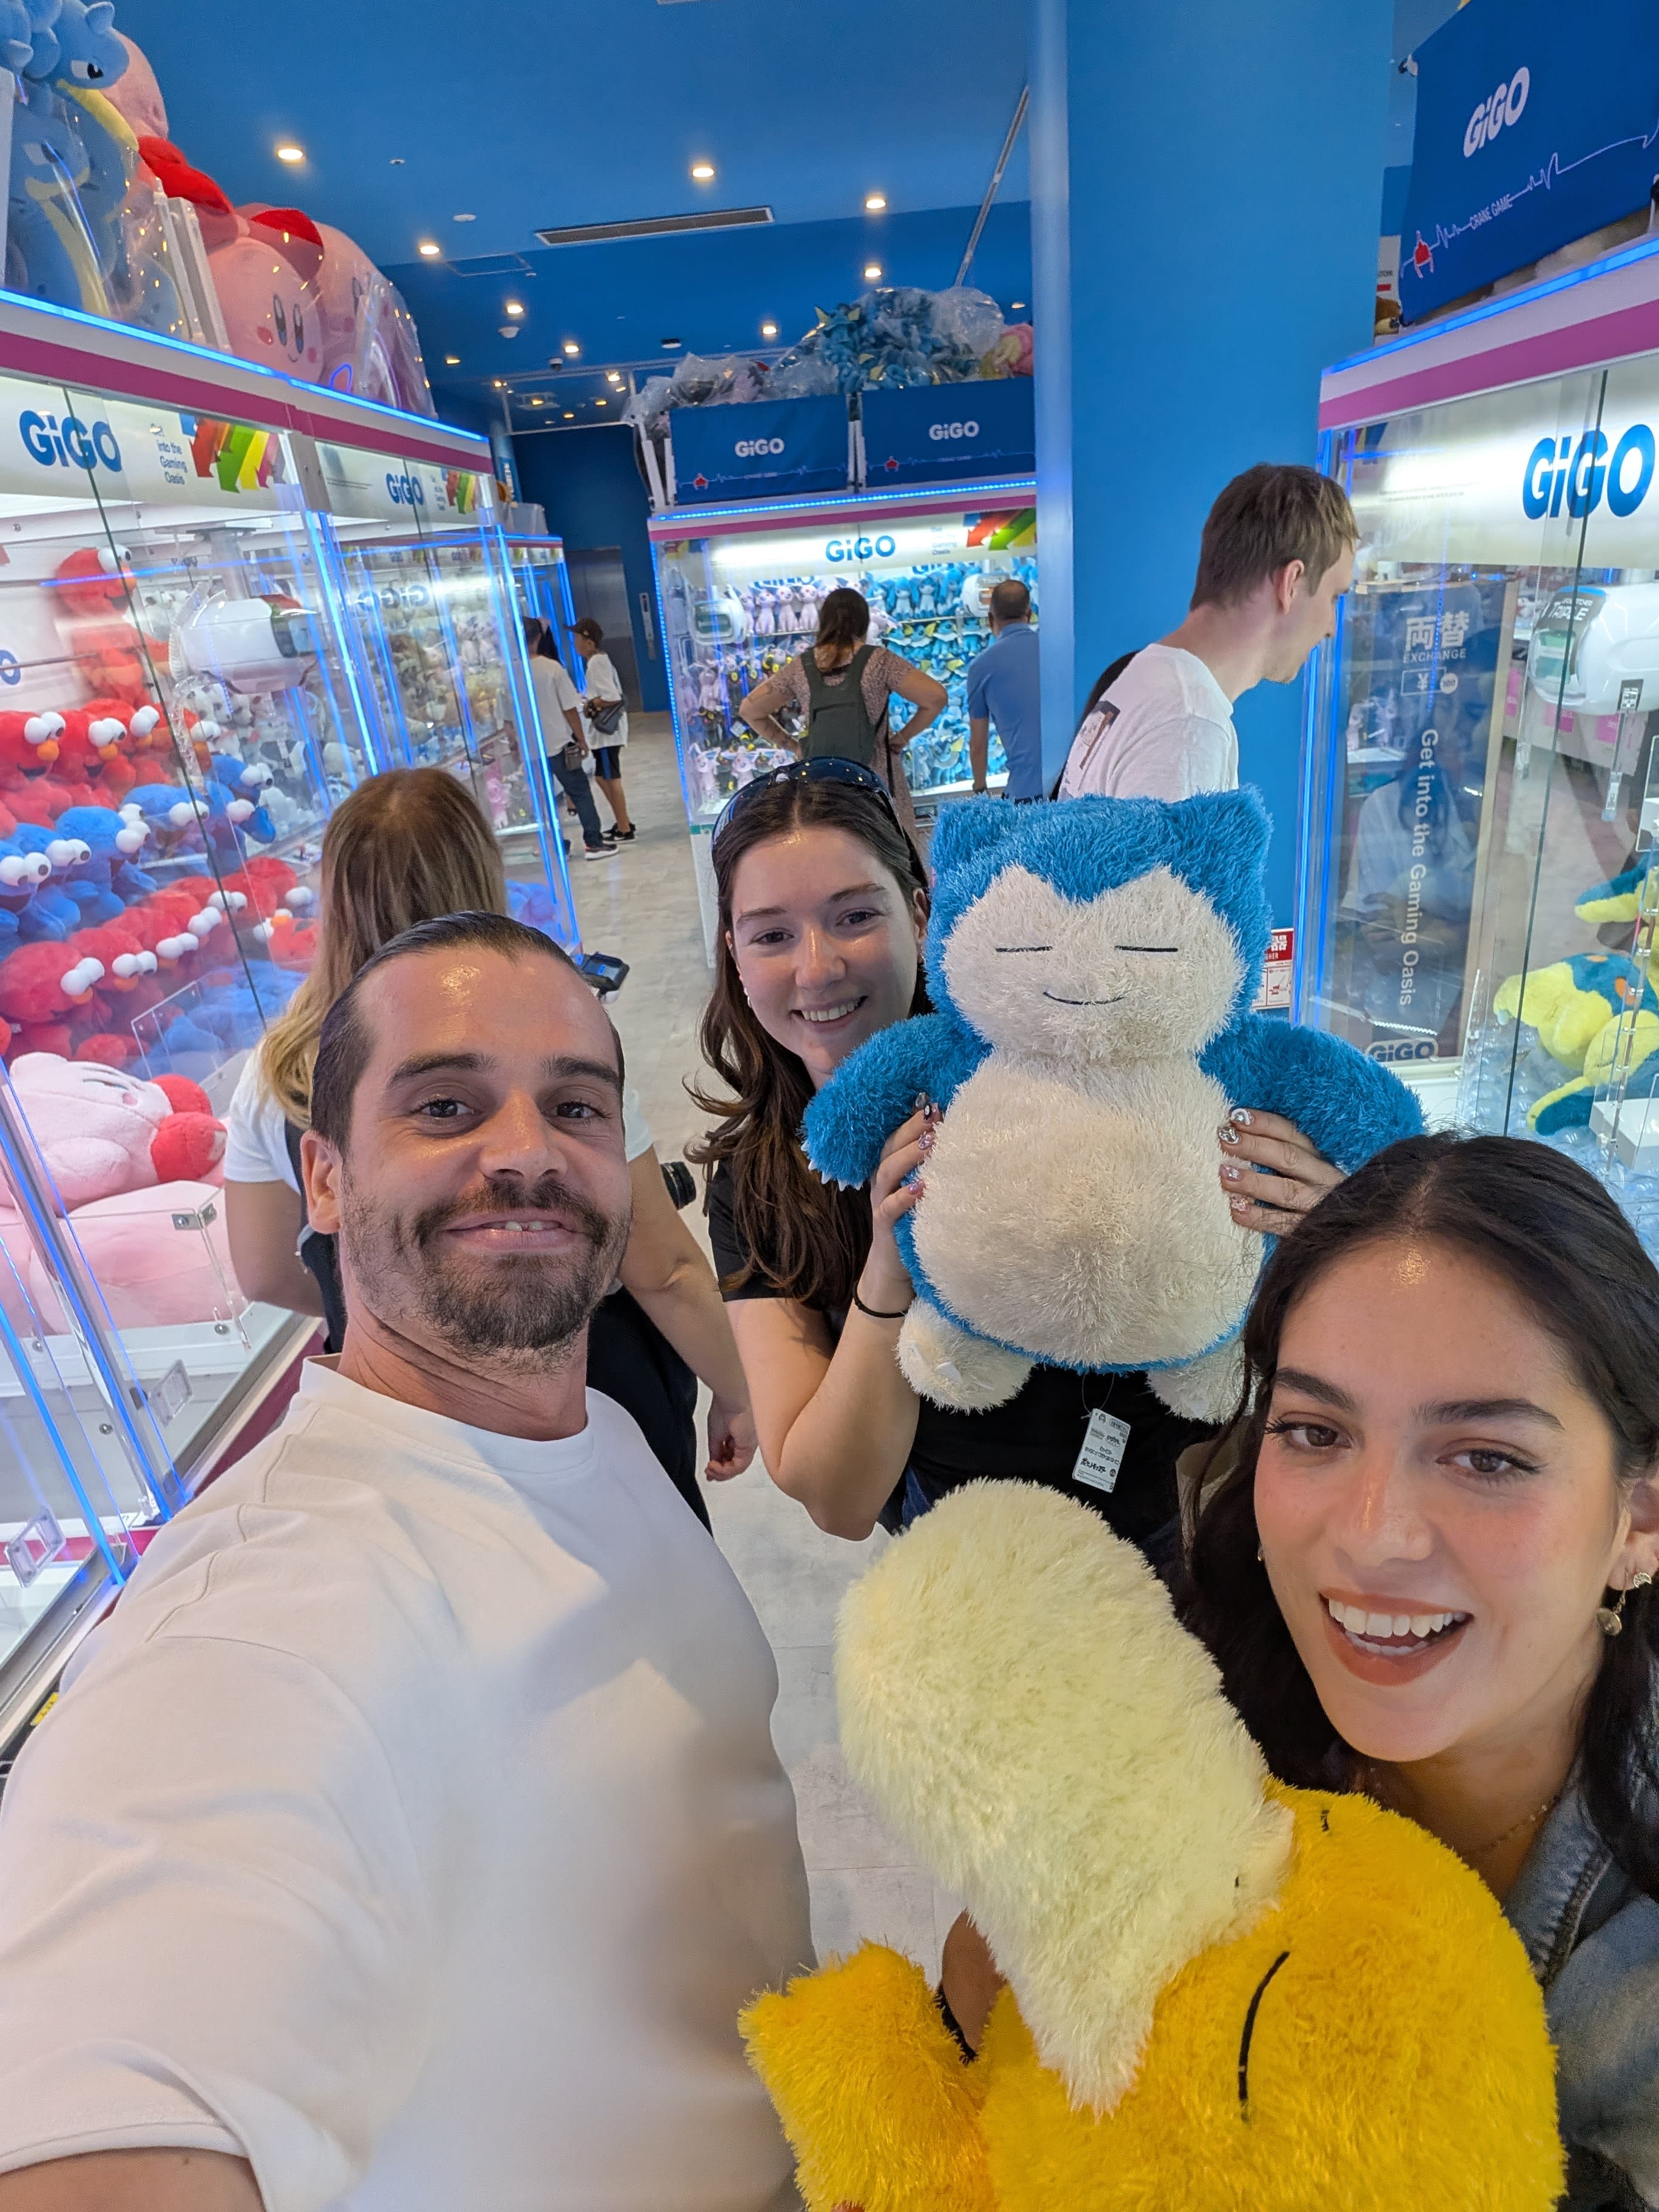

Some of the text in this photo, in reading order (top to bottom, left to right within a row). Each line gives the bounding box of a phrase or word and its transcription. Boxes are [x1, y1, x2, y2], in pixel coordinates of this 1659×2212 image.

[1463, 67, 1530, 158] GiGO
[1469, 193, 1513, 230] CRANE GAME
[19, 410, 122, 472] GiGO
[734, 438, 785, 458] GiGO
[928, 421, 979, 440] GiGO
[386, 473, 424, 505] GiGO
[1523, 424, 1655, 520] GiGO
[826, 535, 896, 562] GiGO
[1405, 611, 1470, 651] 両替
[1399, 729, 1439, 1007] Get into the Gaming Oasis
[1369, 1042, 1435, 1062] GiGO
